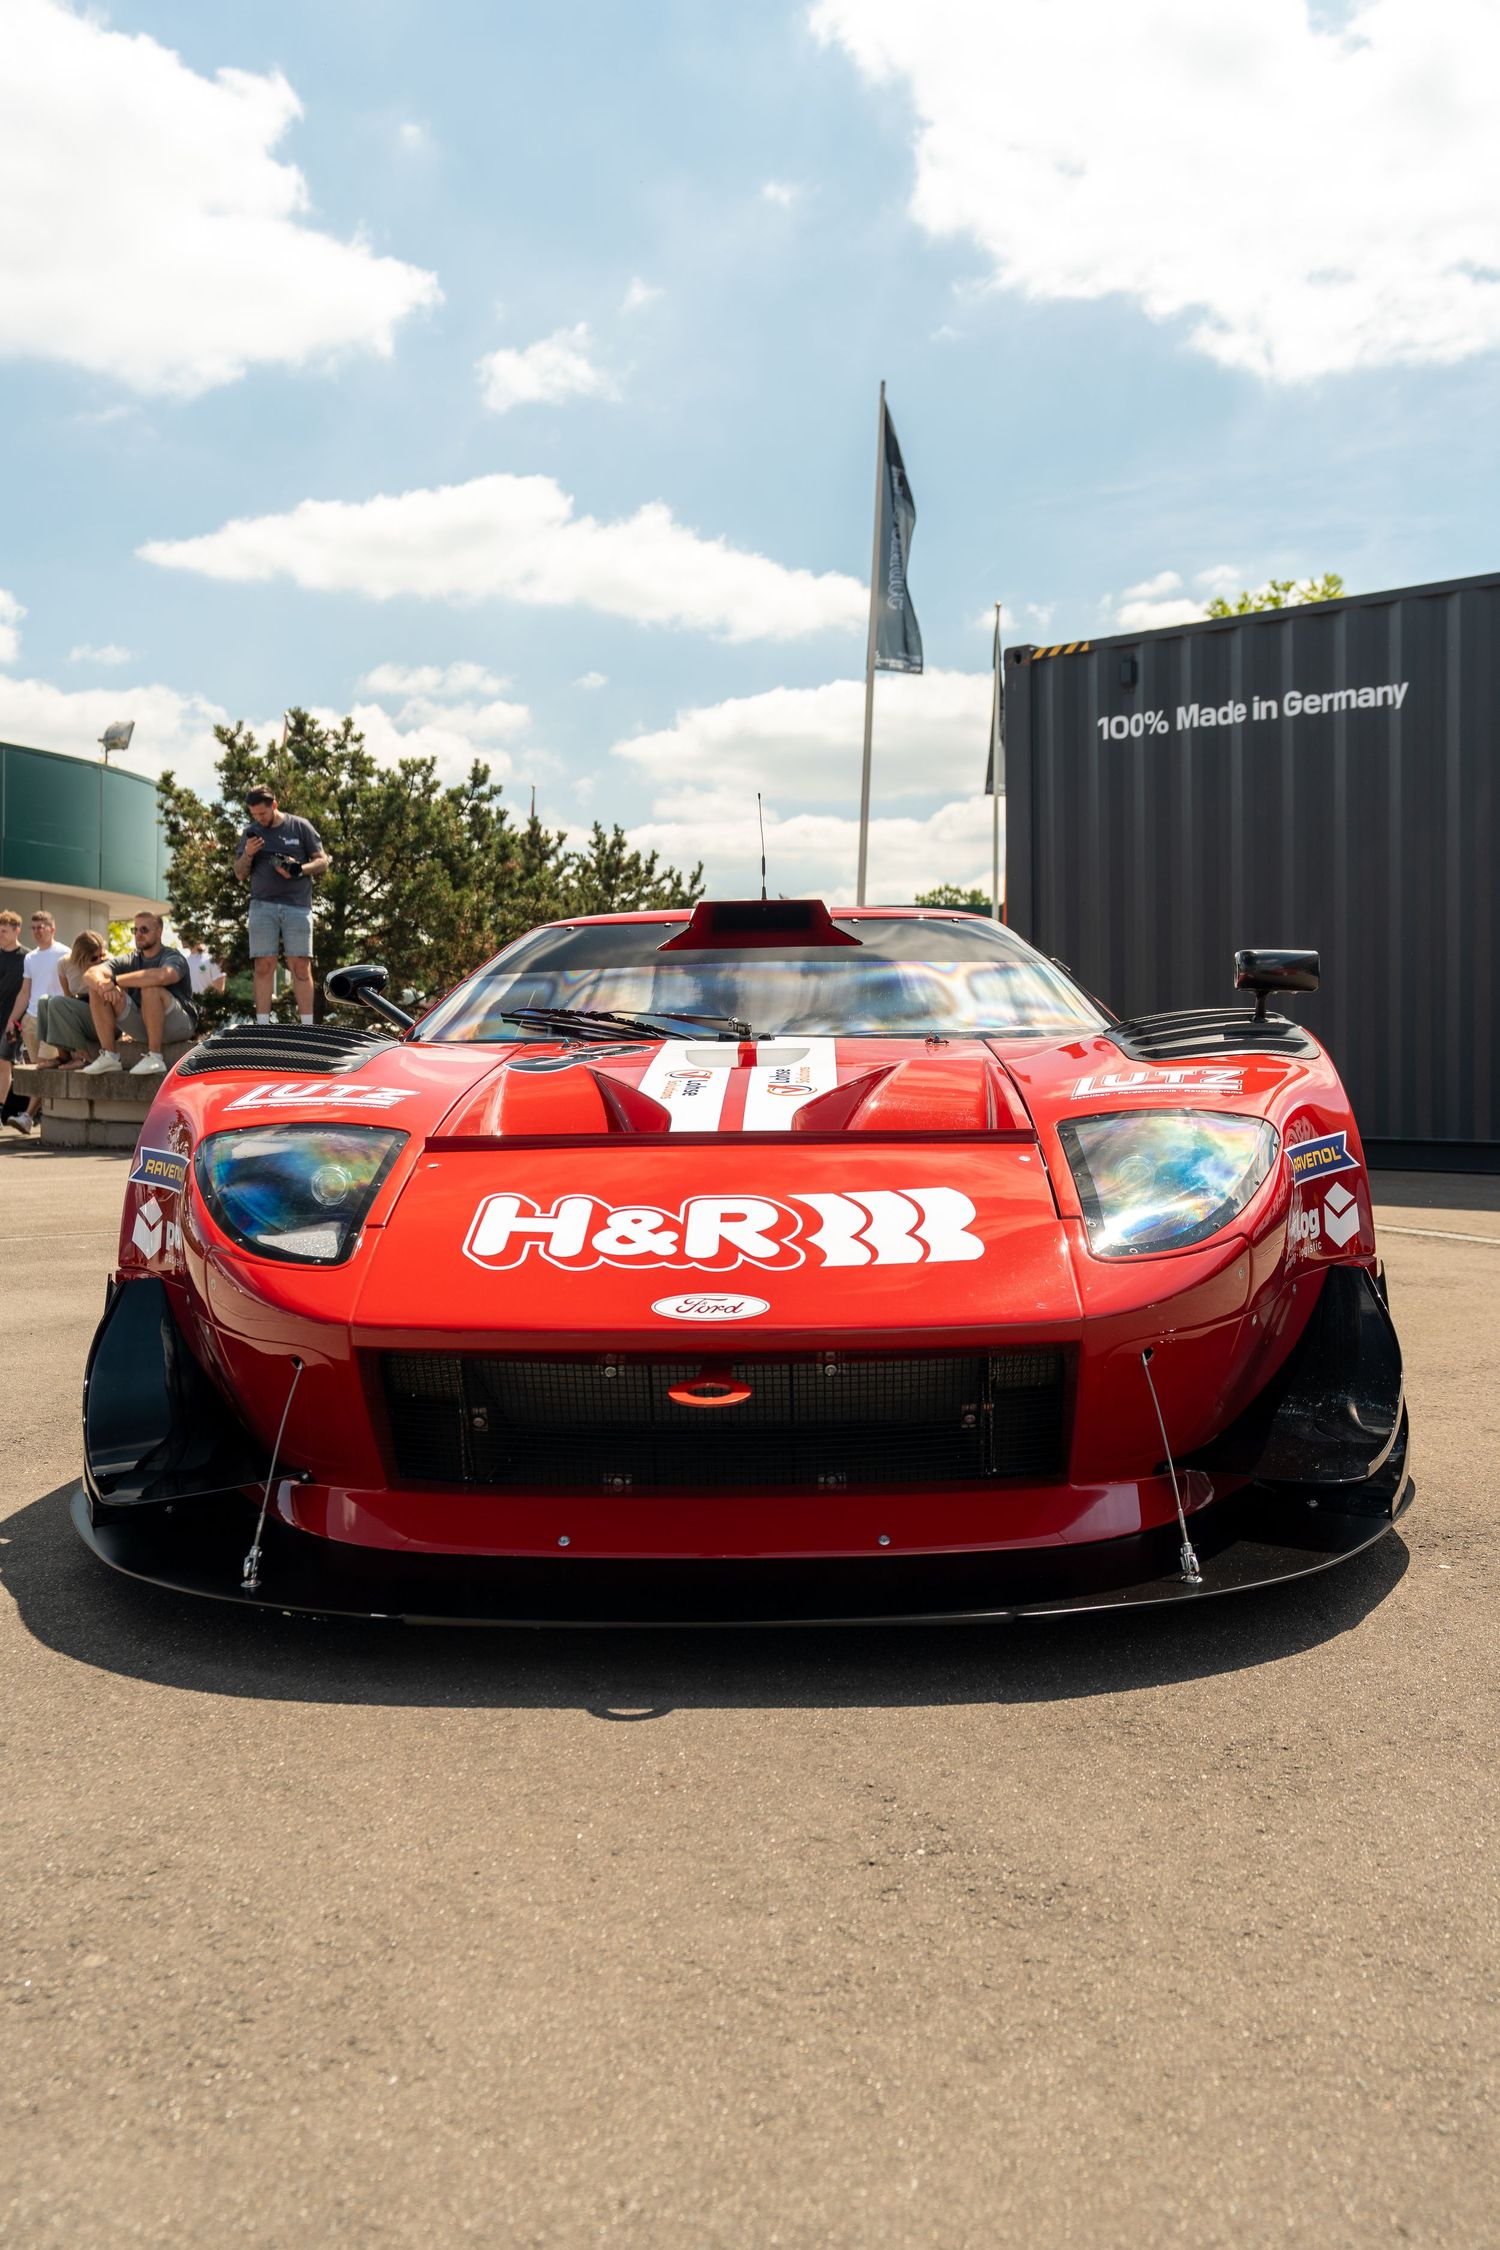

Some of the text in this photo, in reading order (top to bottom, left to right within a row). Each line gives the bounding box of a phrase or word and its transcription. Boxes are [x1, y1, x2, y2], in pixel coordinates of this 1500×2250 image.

[1097, 682, 1409, 740] 100% Made in Germany
[681, 1079, 708, 1097] Lohse
[769, 1068, 791, 1084] Lohse
[1071, 1070, 1244, 1097] LUTZ
[226, 1084, 421, 1108] LUTZ
[468, 1194, 795, 1265] H&R
[675, 1297, 744, 1314] Ford
